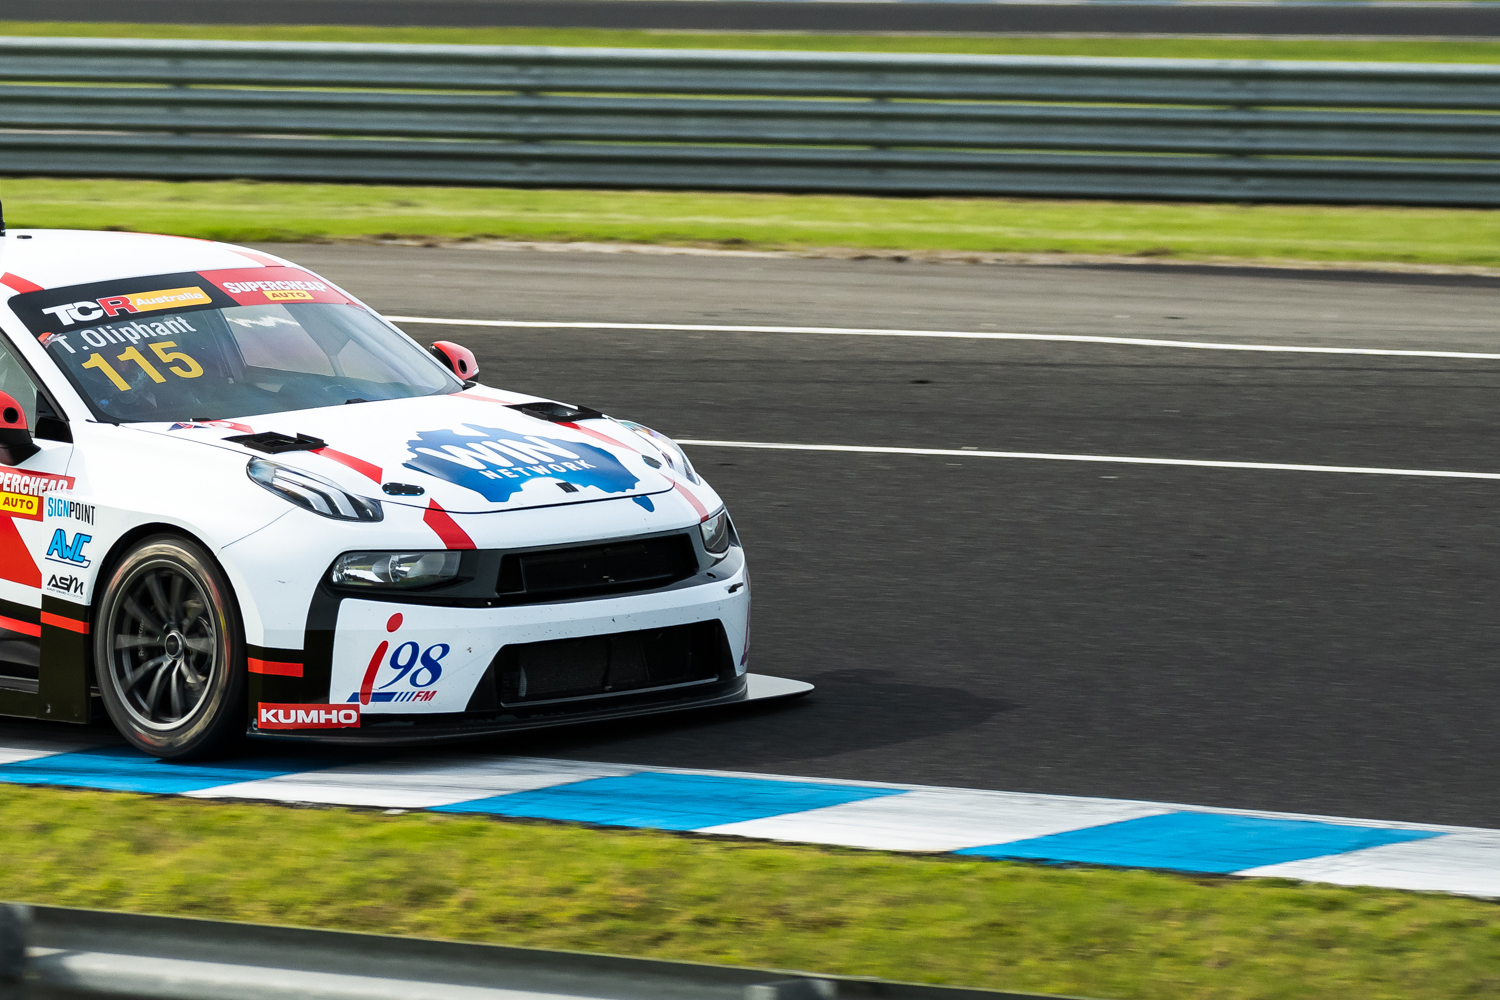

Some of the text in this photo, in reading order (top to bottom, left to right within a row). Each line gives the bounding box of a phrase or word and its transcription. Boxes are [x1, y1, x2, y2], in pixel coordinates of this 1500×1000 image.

[222, 280, 327, 294] SUPERCHEAP
[271, 290, 306, 299] AUTO
[42, 291, 204, 326] TCR Australia
[81, 340, 204, 392] 115
[415, 435, 581, 470] WIN
[478, 459, 596, 480] NETWORK
[2, 496, 34, 510] AUTO
[412, 690, 438, 702] FM
[260, 708, 358, 724] KUMHO
